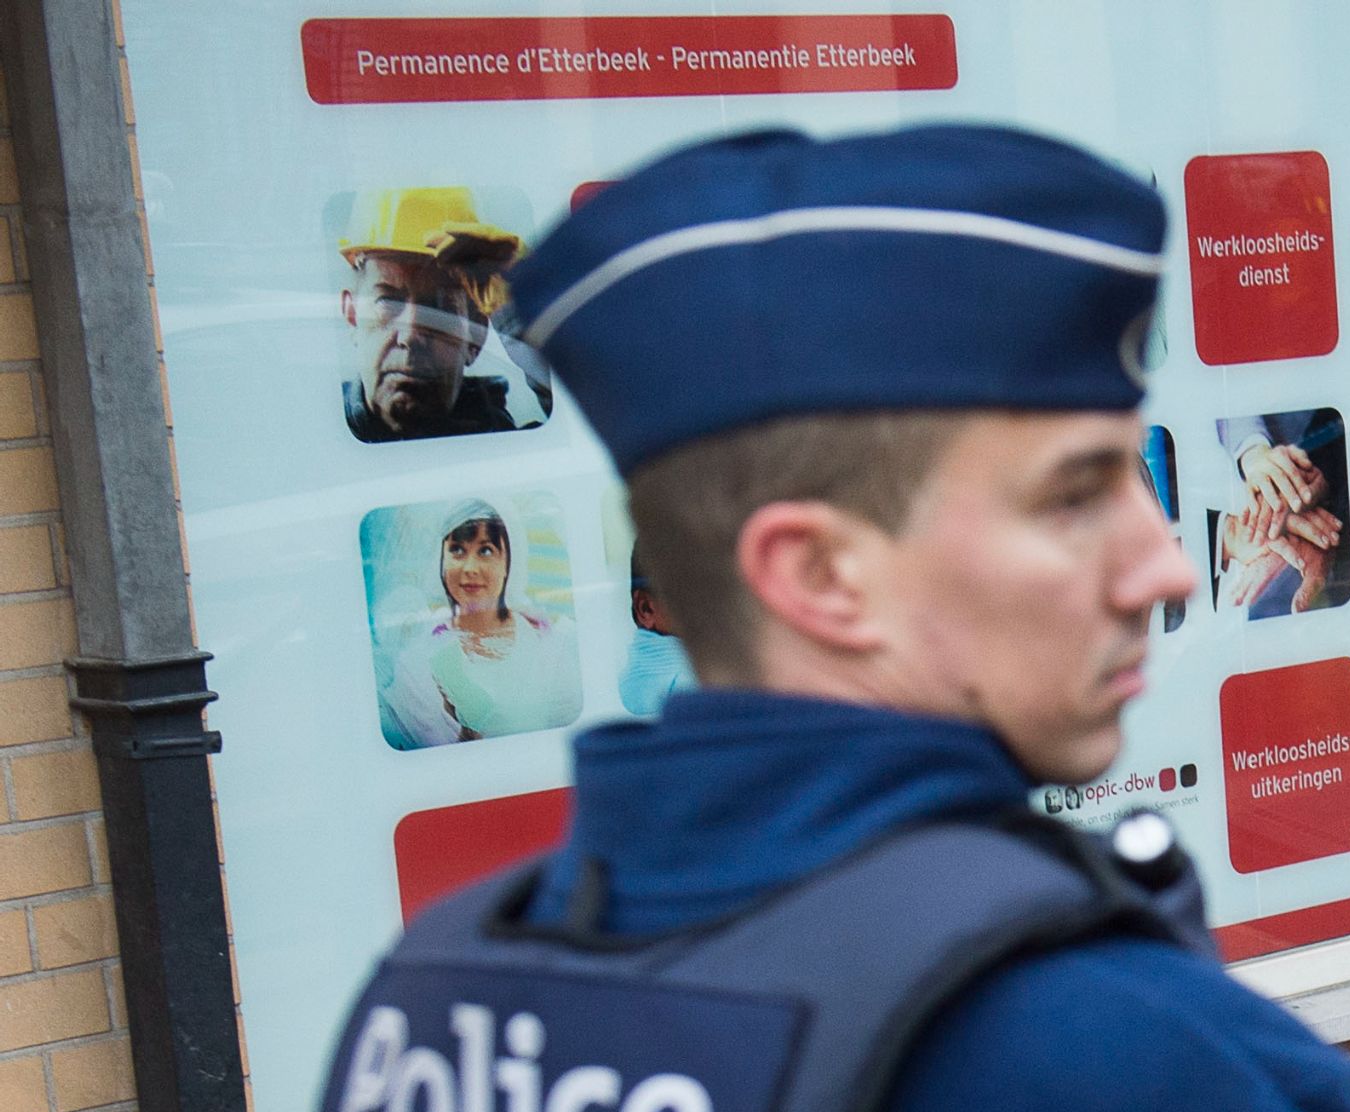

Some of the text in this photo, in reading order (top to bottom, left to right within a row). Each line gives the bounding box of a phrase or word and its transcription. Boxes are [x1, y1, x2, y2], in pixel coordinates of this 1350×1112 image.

[357, 49, 509, 76] Permanence
[517, 47, 650, 73] d'Etterbeek
[672, 44, 809, 70] Permanentie
[817, 42, 916, 68] Etterbeek
[1197, 230, 1325, 258] Werkloosheids-
[1239, 263, 1290, 288] dienst
[1251, 767, 1343, 799] uitkeringen
